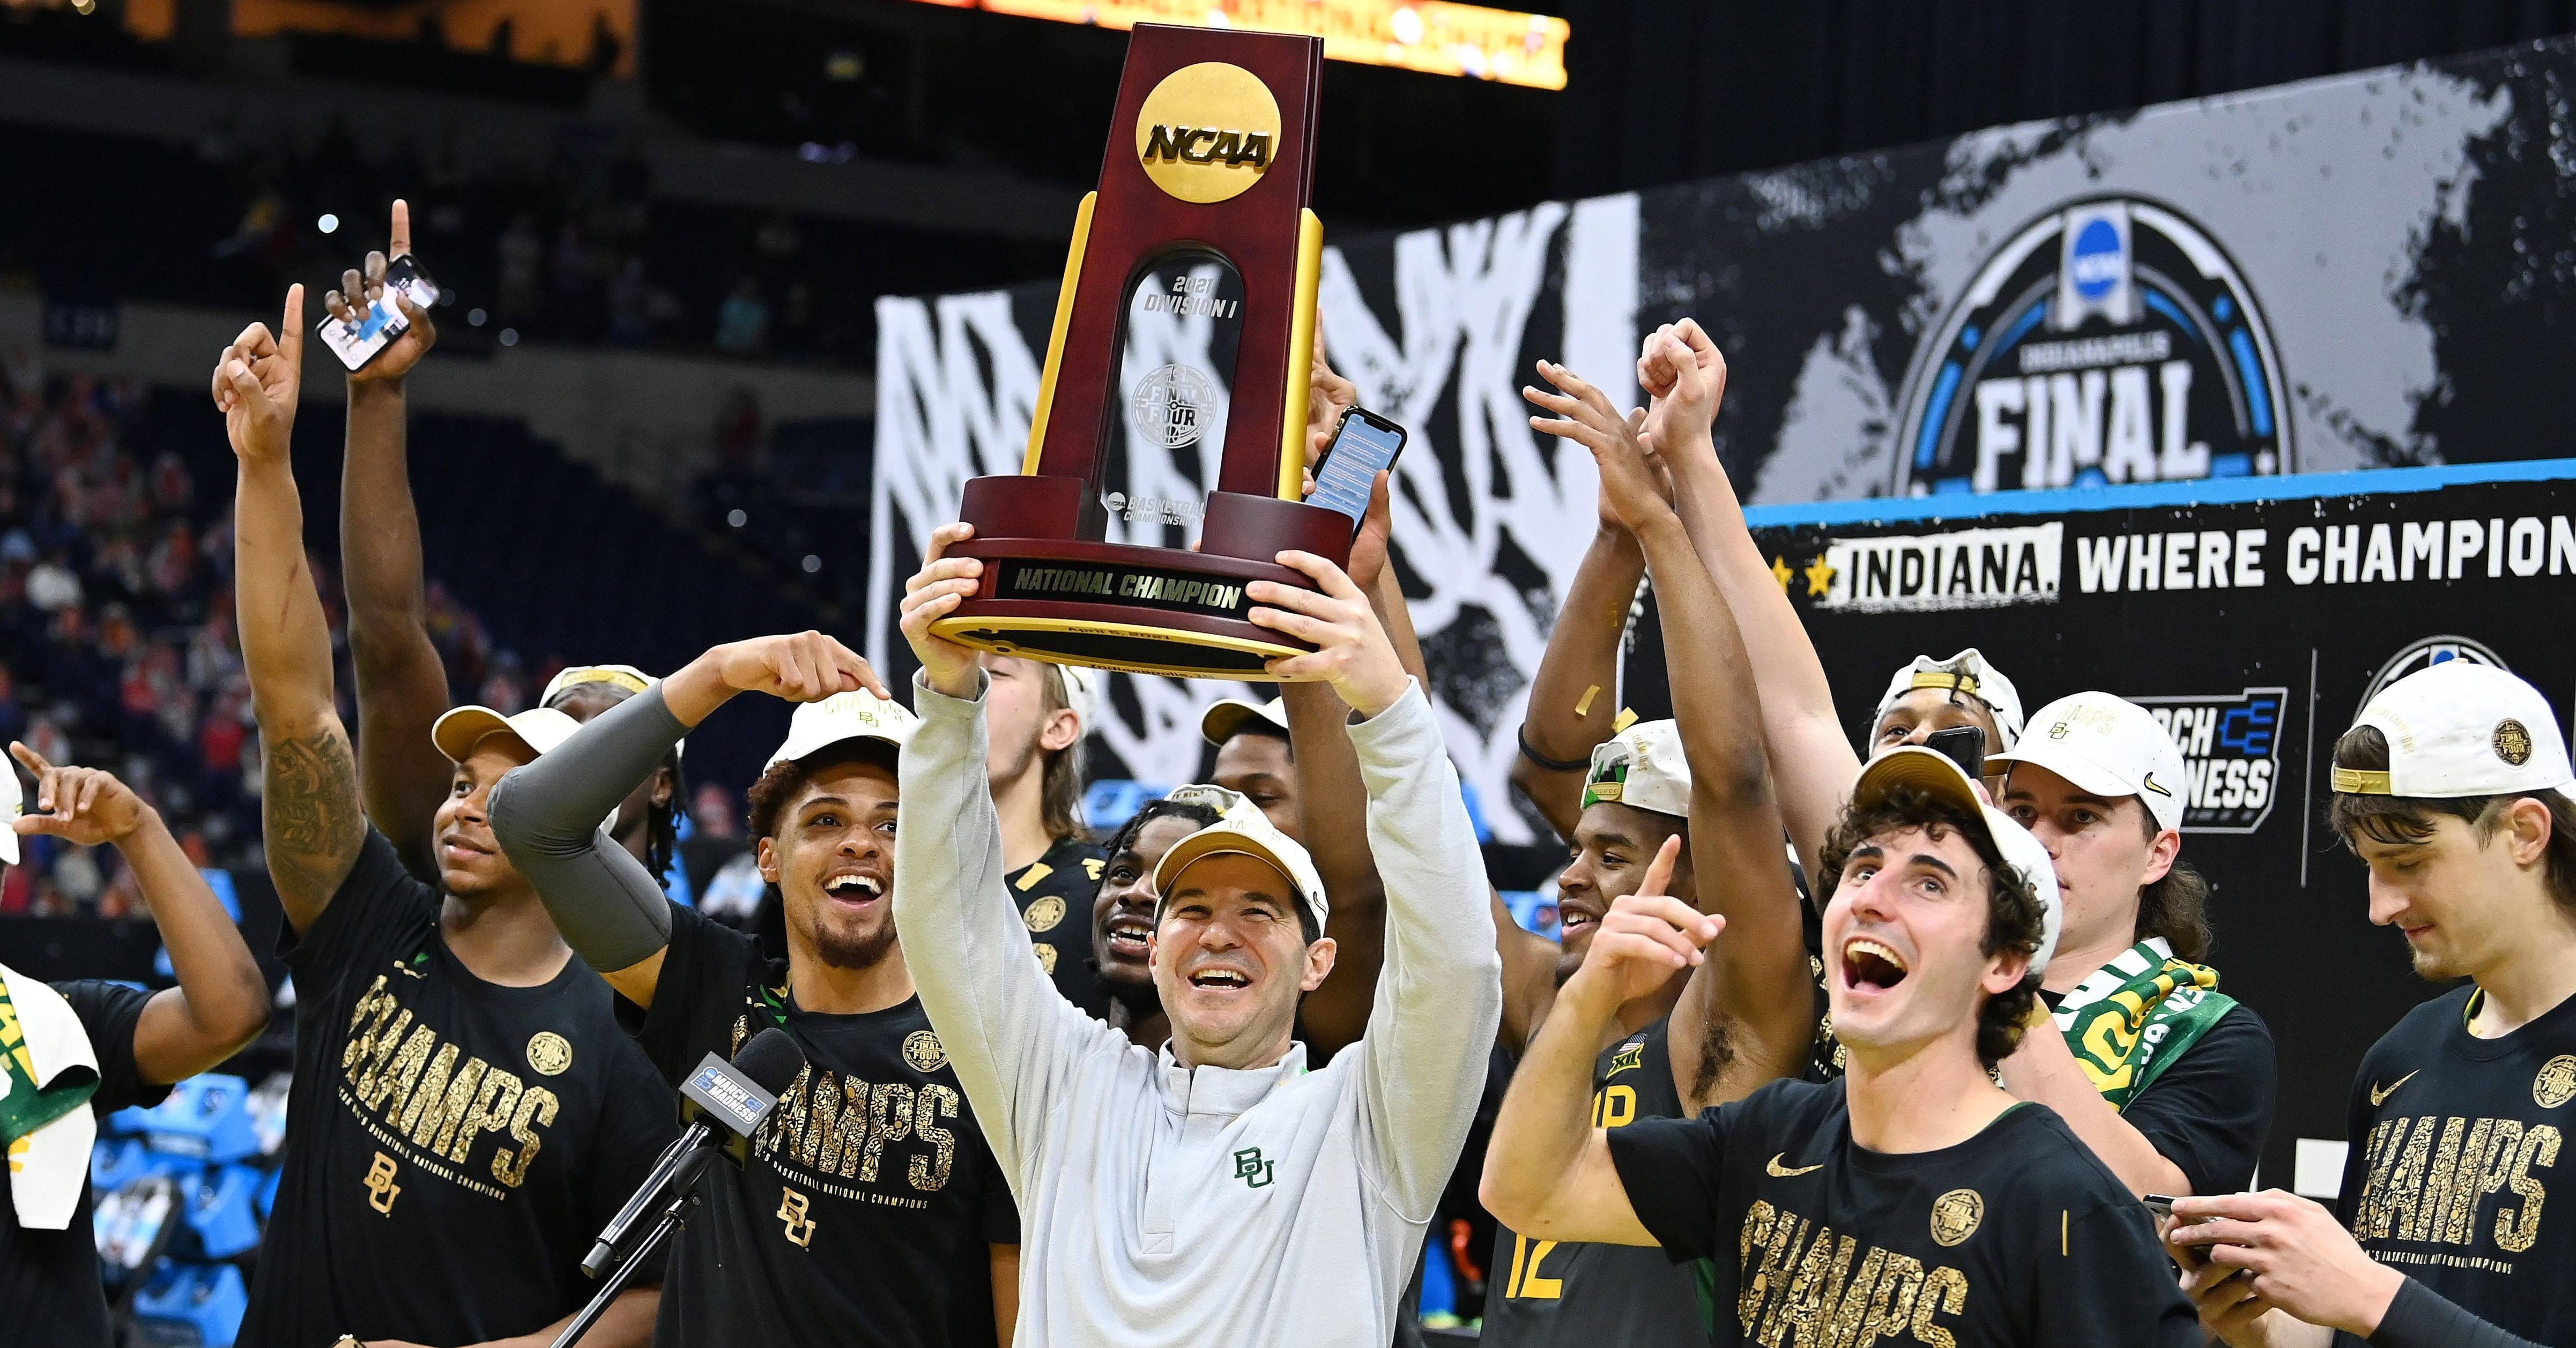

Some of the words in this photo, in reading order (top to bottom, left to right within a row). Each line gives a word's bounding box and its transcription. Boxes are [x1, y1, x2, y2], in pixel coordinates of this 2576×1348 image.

[1142, 124, 1272, 174] NCAA
[1172, 276, 1213, 294] 2021
[1144, 294, 1227, 317] DIVISION
[1228, 300, 1238, 318] I
[1148, 406, 1196, 426] FOUR
[1972, 361, 2211, 494] FINAL
[2077, 528, 2267, 593] WHERE
[1015, 568, 1113, 596] NATIONAL
[1119, 574, 1243, 610] CHAMPION
[858, 711, 878, 727] BU
[2048, 722, 2070, 740] BU
[2184, 758, 2273, 809] NESS
[913, 1052, 940, 1060] FOUR
[914, 1041, 941, 1050] FINAL
[711, 1074, 749, 1103] MARCH
[2541, 1079, 2570, 1097] FOUR
[2548, 1067, 2575, 1083] FINAL
[708, 1085, 756, 1121] MADNESS
[363, 1150, 402, 1214] BU
[413, 1155, 454, 1181] NATIONAL
[457, 1174, 506, 1201] CHAMPIONS
[773, 1161, 819, 1190] BASKETBALL
[823, 1183, 865, 1202] NATIONAL
[871, 1194, 928, 1209] CHAMPIONS
[1234, 1146, 1274, 1188] BU
[2352, 1116, 2563, 1253] HAMPS
[776, 1186, 816, 1248] BU
[2381, 1250, 2427, 1265] BASKETBALL
